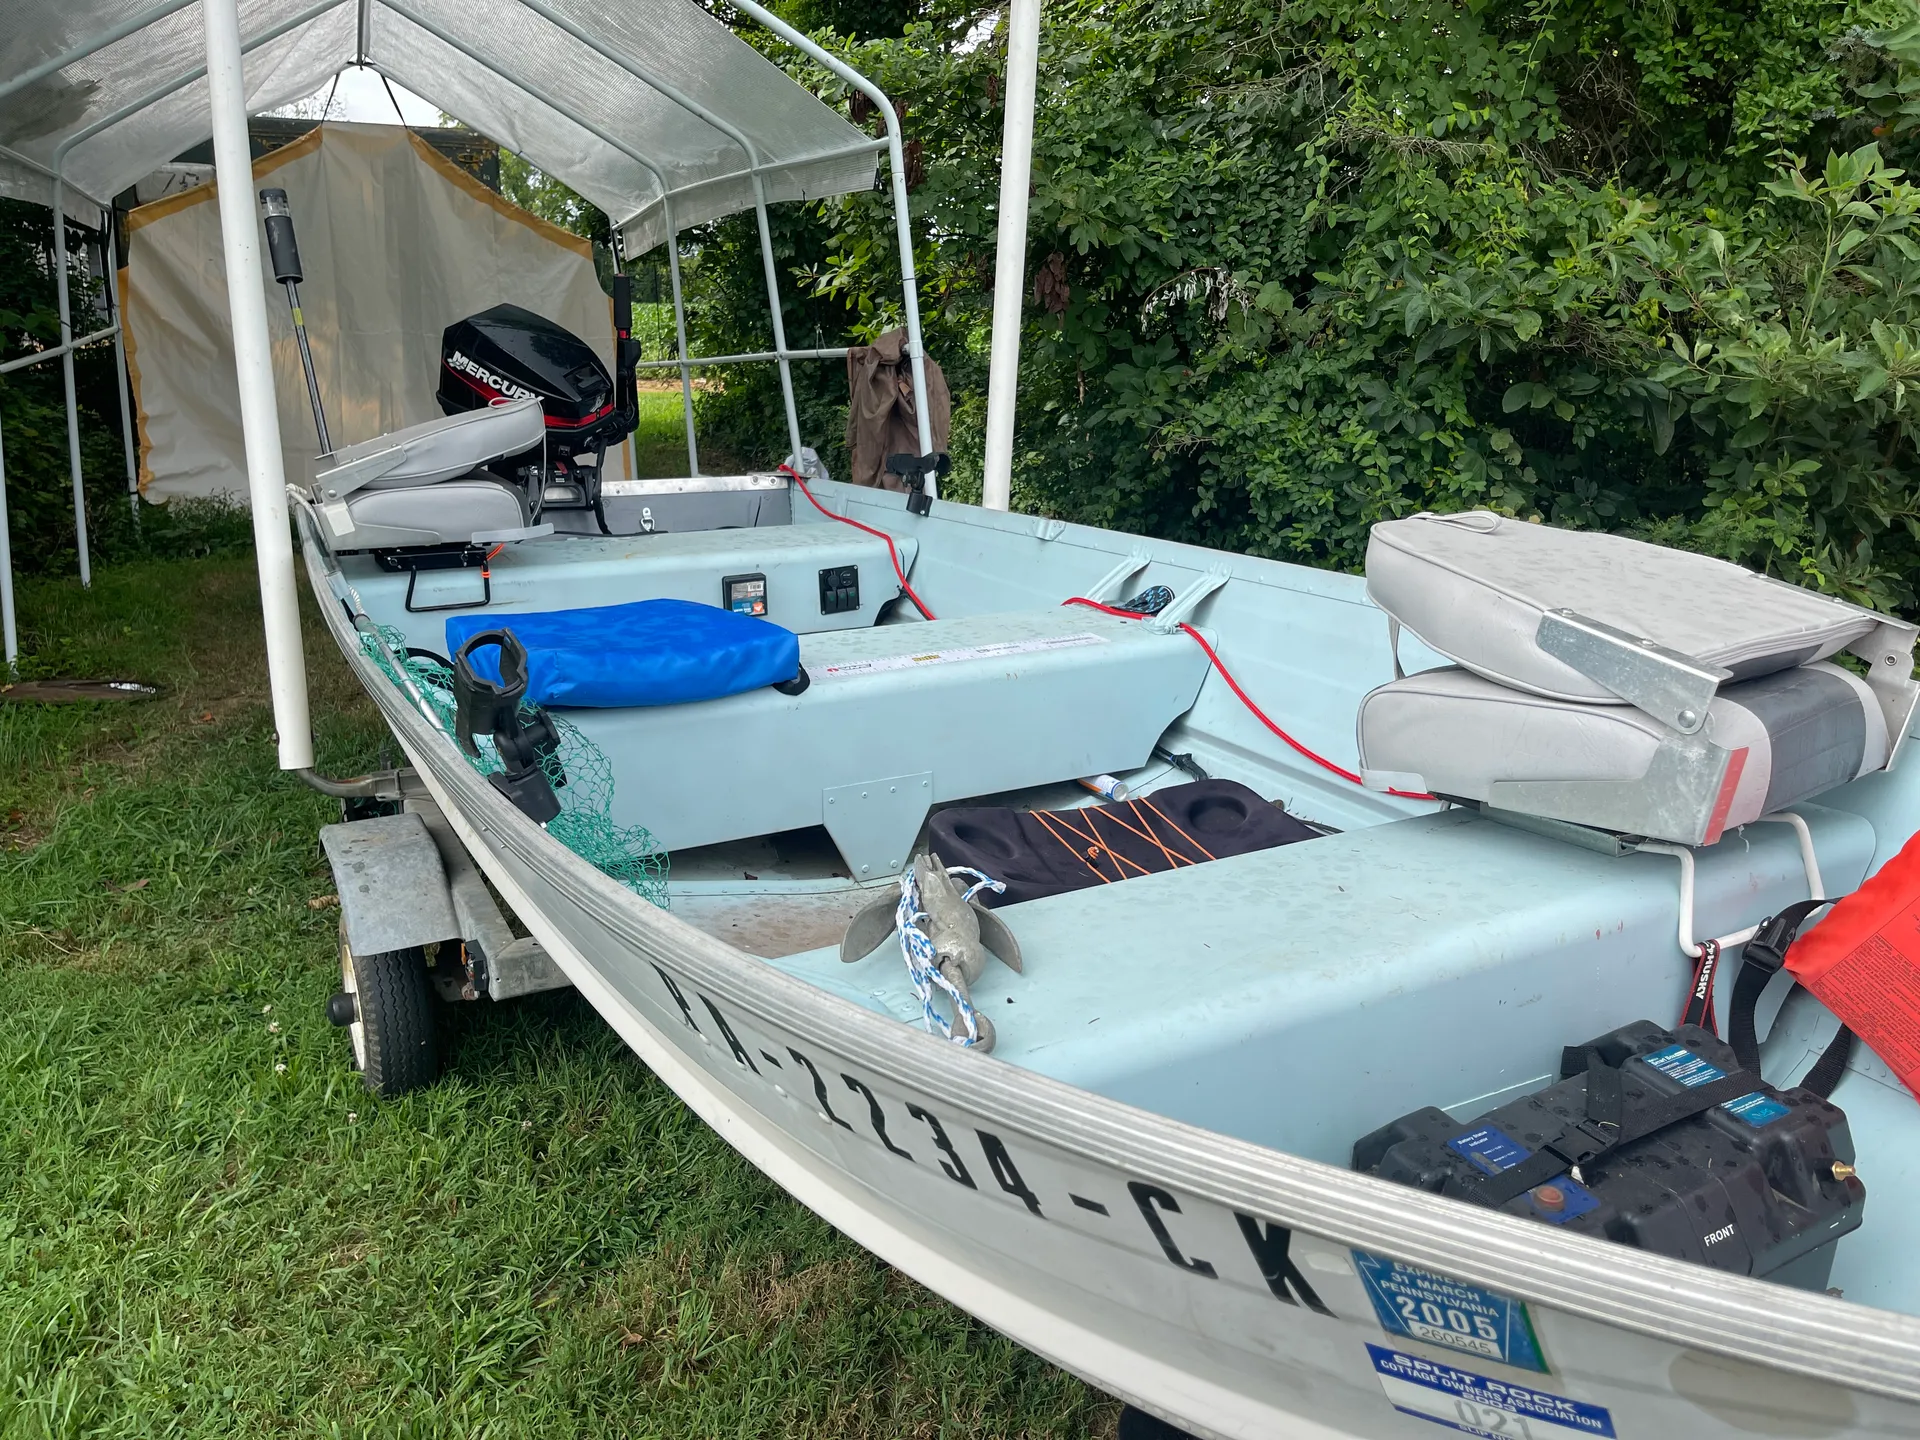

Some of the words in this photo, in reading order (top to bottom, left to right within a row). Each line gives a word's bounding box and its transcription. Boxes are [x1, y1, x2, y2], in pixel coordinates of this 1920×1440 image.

[452, 351, 545, 402] MERCURY
[1695, 955, 1715, 1000] HUSKY
[1703, 1223, 1735, 1247] FRONT
[1380, 1279, 1500, 1318] PENNSYLVANIA
[1390, 1272, 1410, 1285] 31
[1416, 1279, 1481, 1302] MARCH
[1396, 1295, 1499, 1340] 2005
[1419, 1326, 1492, 1355] 260545
[1380, 1359, 1439, 1384] COTTAGE
[1441, 1378, 1503, 1402] OWNERS
[1507, 1396, 1603, 1429] ASSOCIATION
[1393, 1354, 1476, 1385] SPLIT
[1485, 1381, 1578, 1414] ROCK
